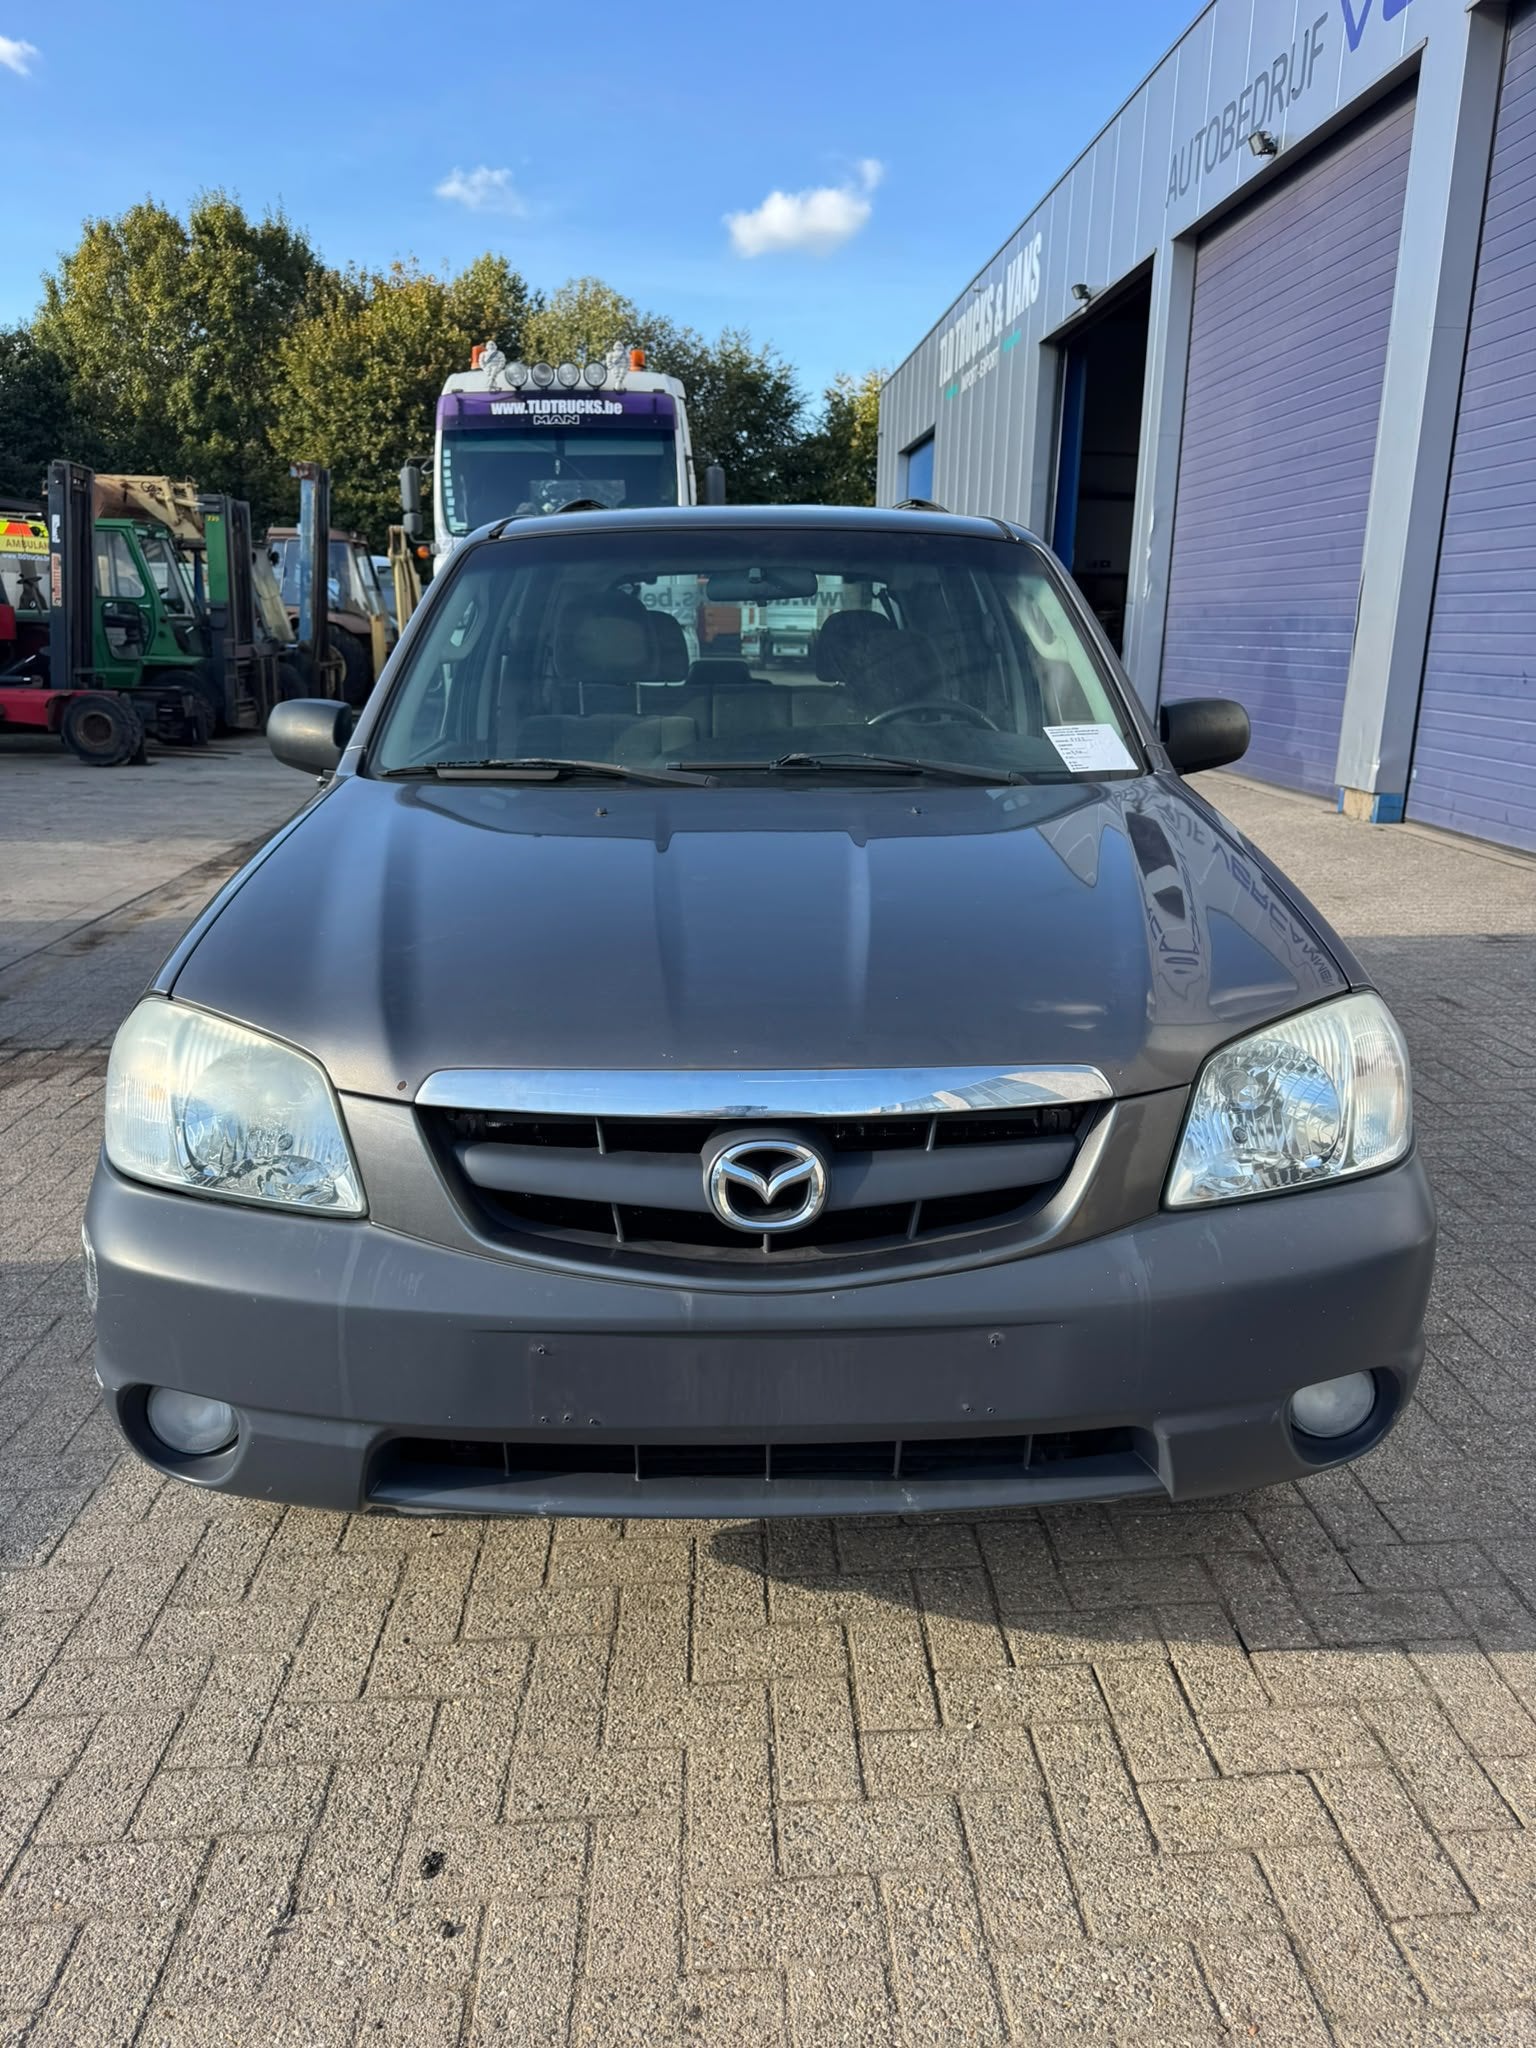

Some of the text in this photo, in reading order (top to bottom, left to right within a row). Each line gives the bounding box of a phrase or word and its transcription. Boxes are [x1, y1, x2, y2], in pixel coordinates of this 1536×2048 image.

[1165, 12, 1328, 208] AUTOBEDRIJF
[1006, 232, 1042, 327] VANS
[490, 400, 623, 415] www.TLDTRUCKS.be
[533, 415, 580, 425] MAN
